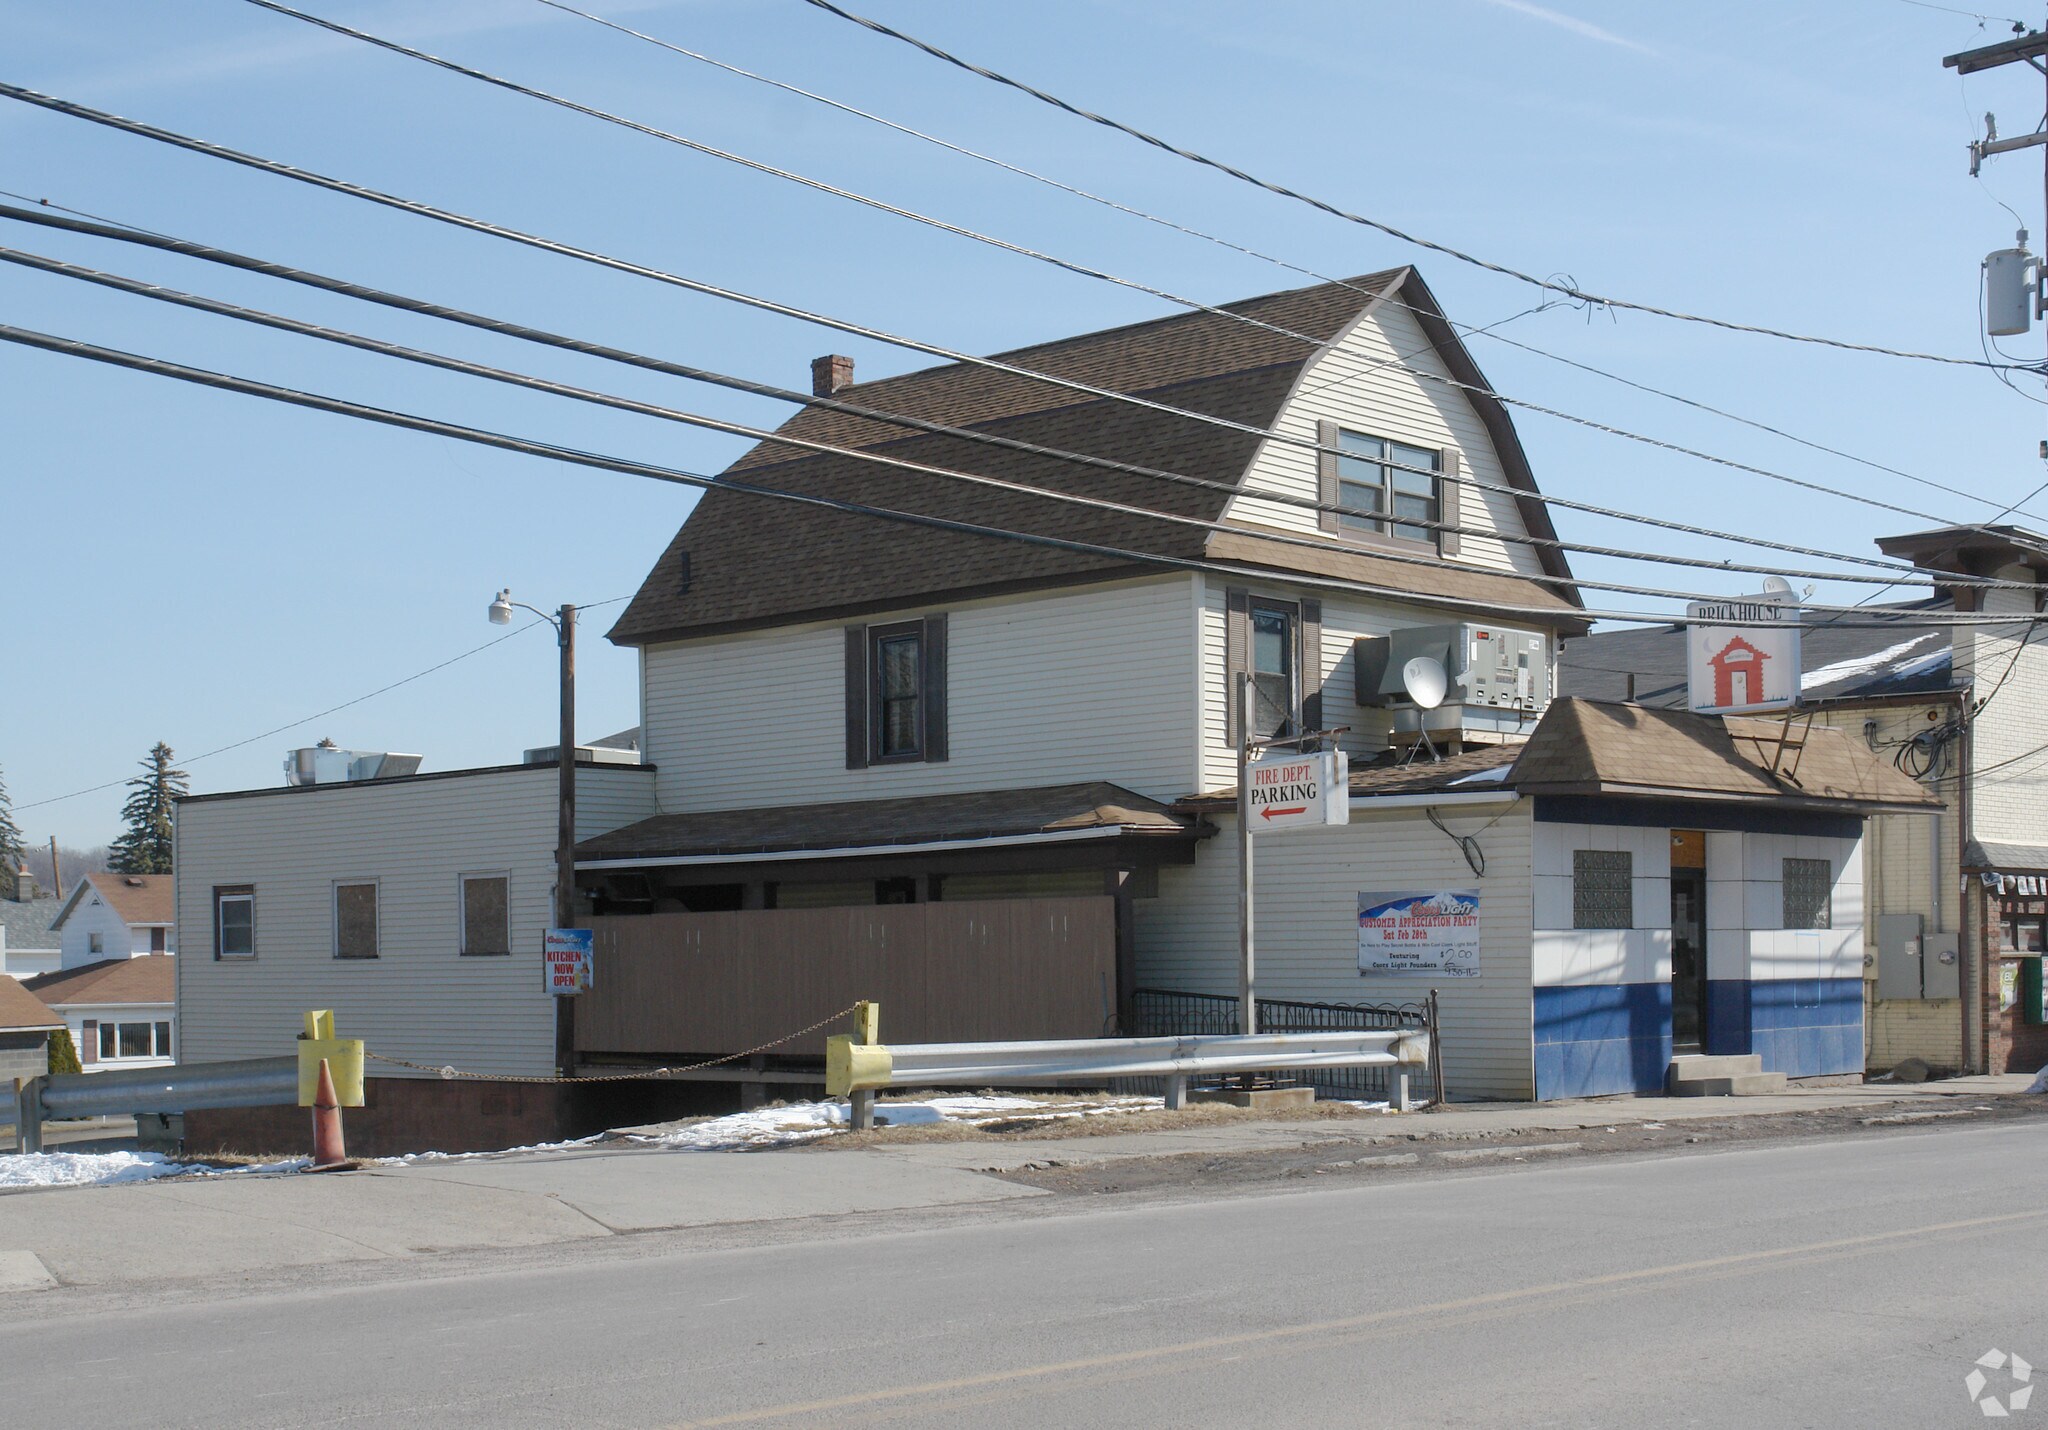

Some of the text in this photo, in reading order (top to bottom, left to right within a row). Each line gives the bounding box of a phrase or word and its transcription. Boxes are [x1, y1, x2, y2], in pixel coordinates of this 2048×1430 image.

[1699, 598, 1782, 629] BRICKHOUSE
[1255, 765, 1312, 785] FIRE DEPT.
[1251, 782, 1317, 805] PARKING
[1440, 903, 1474, 916] LIGHT
[1360, 915, 1478, 928] CUSTOMER APPRECIATION PARTY
[1383, 929, 1427, 940] Sat Feb 28th
[547, 951, 581, 962] KITCHEN
[554, 963, 575, 974] NOW
[553, 975, 575, 987] OPEN
